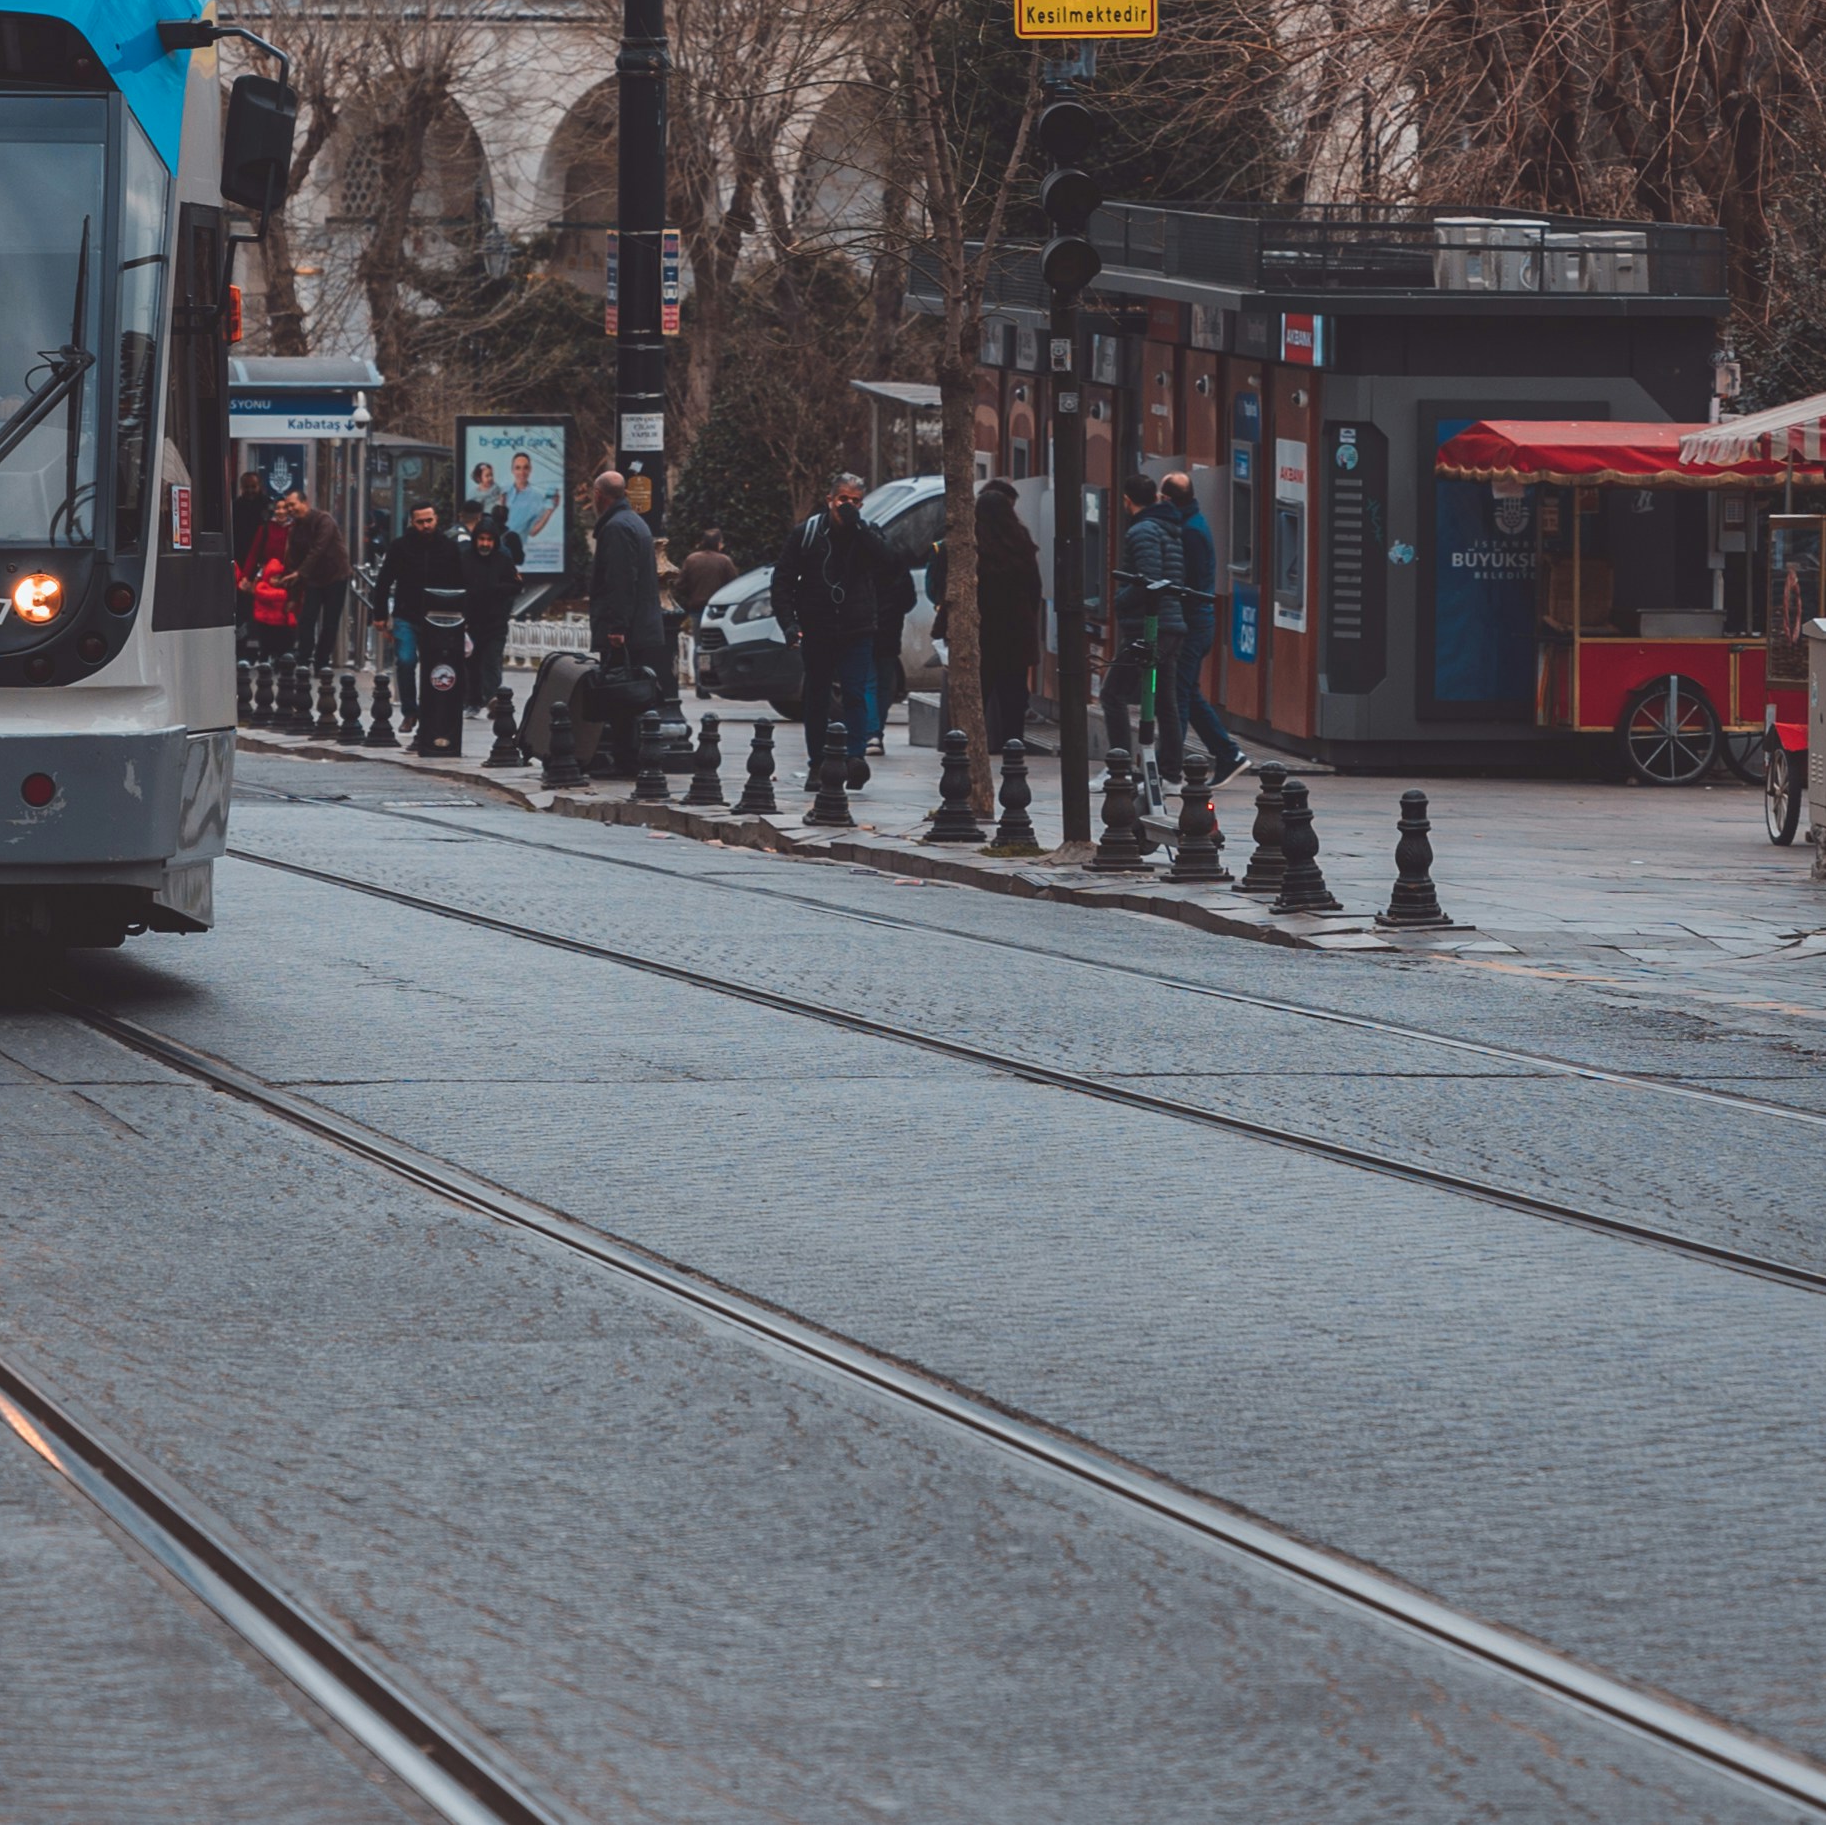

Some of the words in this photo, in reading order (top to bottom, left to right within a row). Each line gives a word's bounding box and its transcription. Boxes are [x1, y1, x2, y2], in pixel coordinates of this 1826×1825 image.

[1026, 6, 1148, 24] Kesilmektedir
[287, 418, 341, 432] Kabataş
[479, 435, 524, 449] b-good
